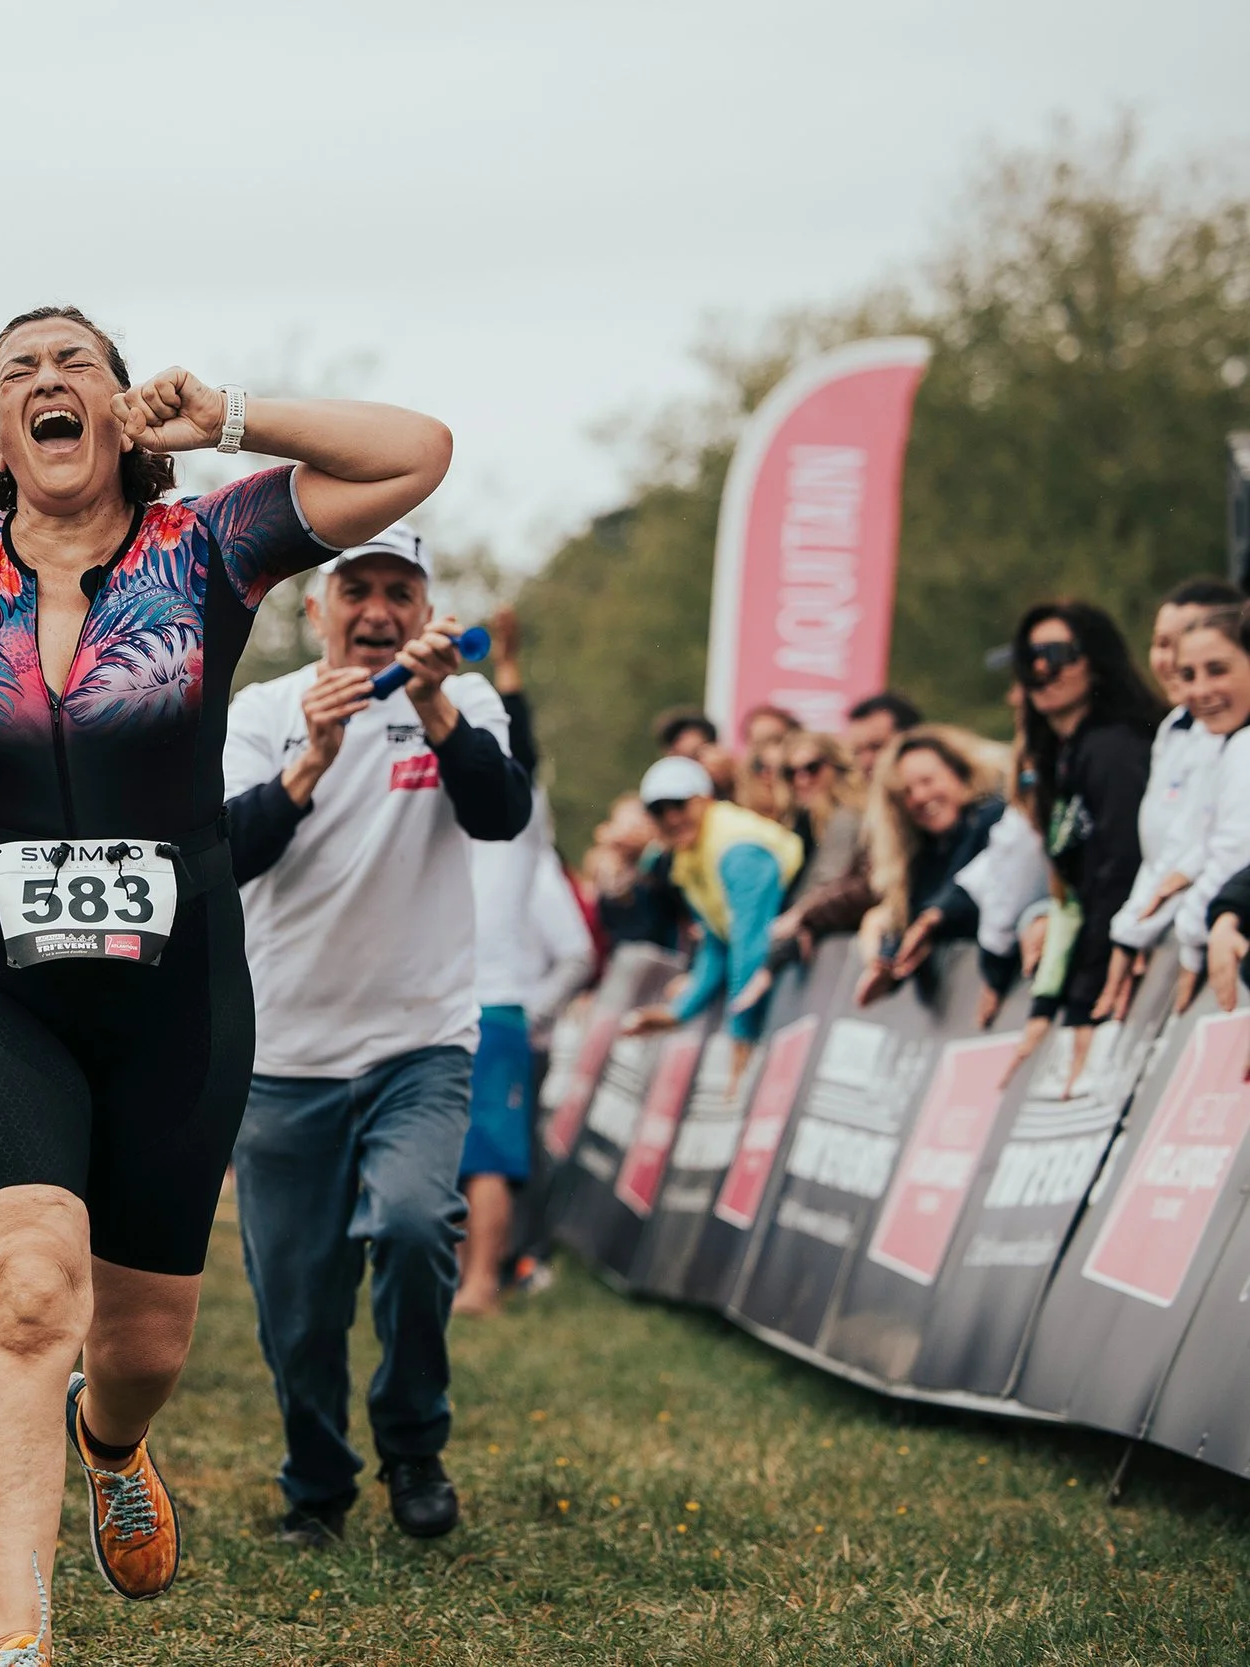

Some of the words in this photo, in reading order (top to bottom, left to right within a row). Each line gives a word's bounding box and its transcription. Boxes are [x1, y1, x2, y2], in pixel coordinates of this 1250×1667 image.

[21, 845, 144, 863] SWIMO
[21, 875, 154, 924] 583
[36, 942, 98, 953] TRI'EVENTS
